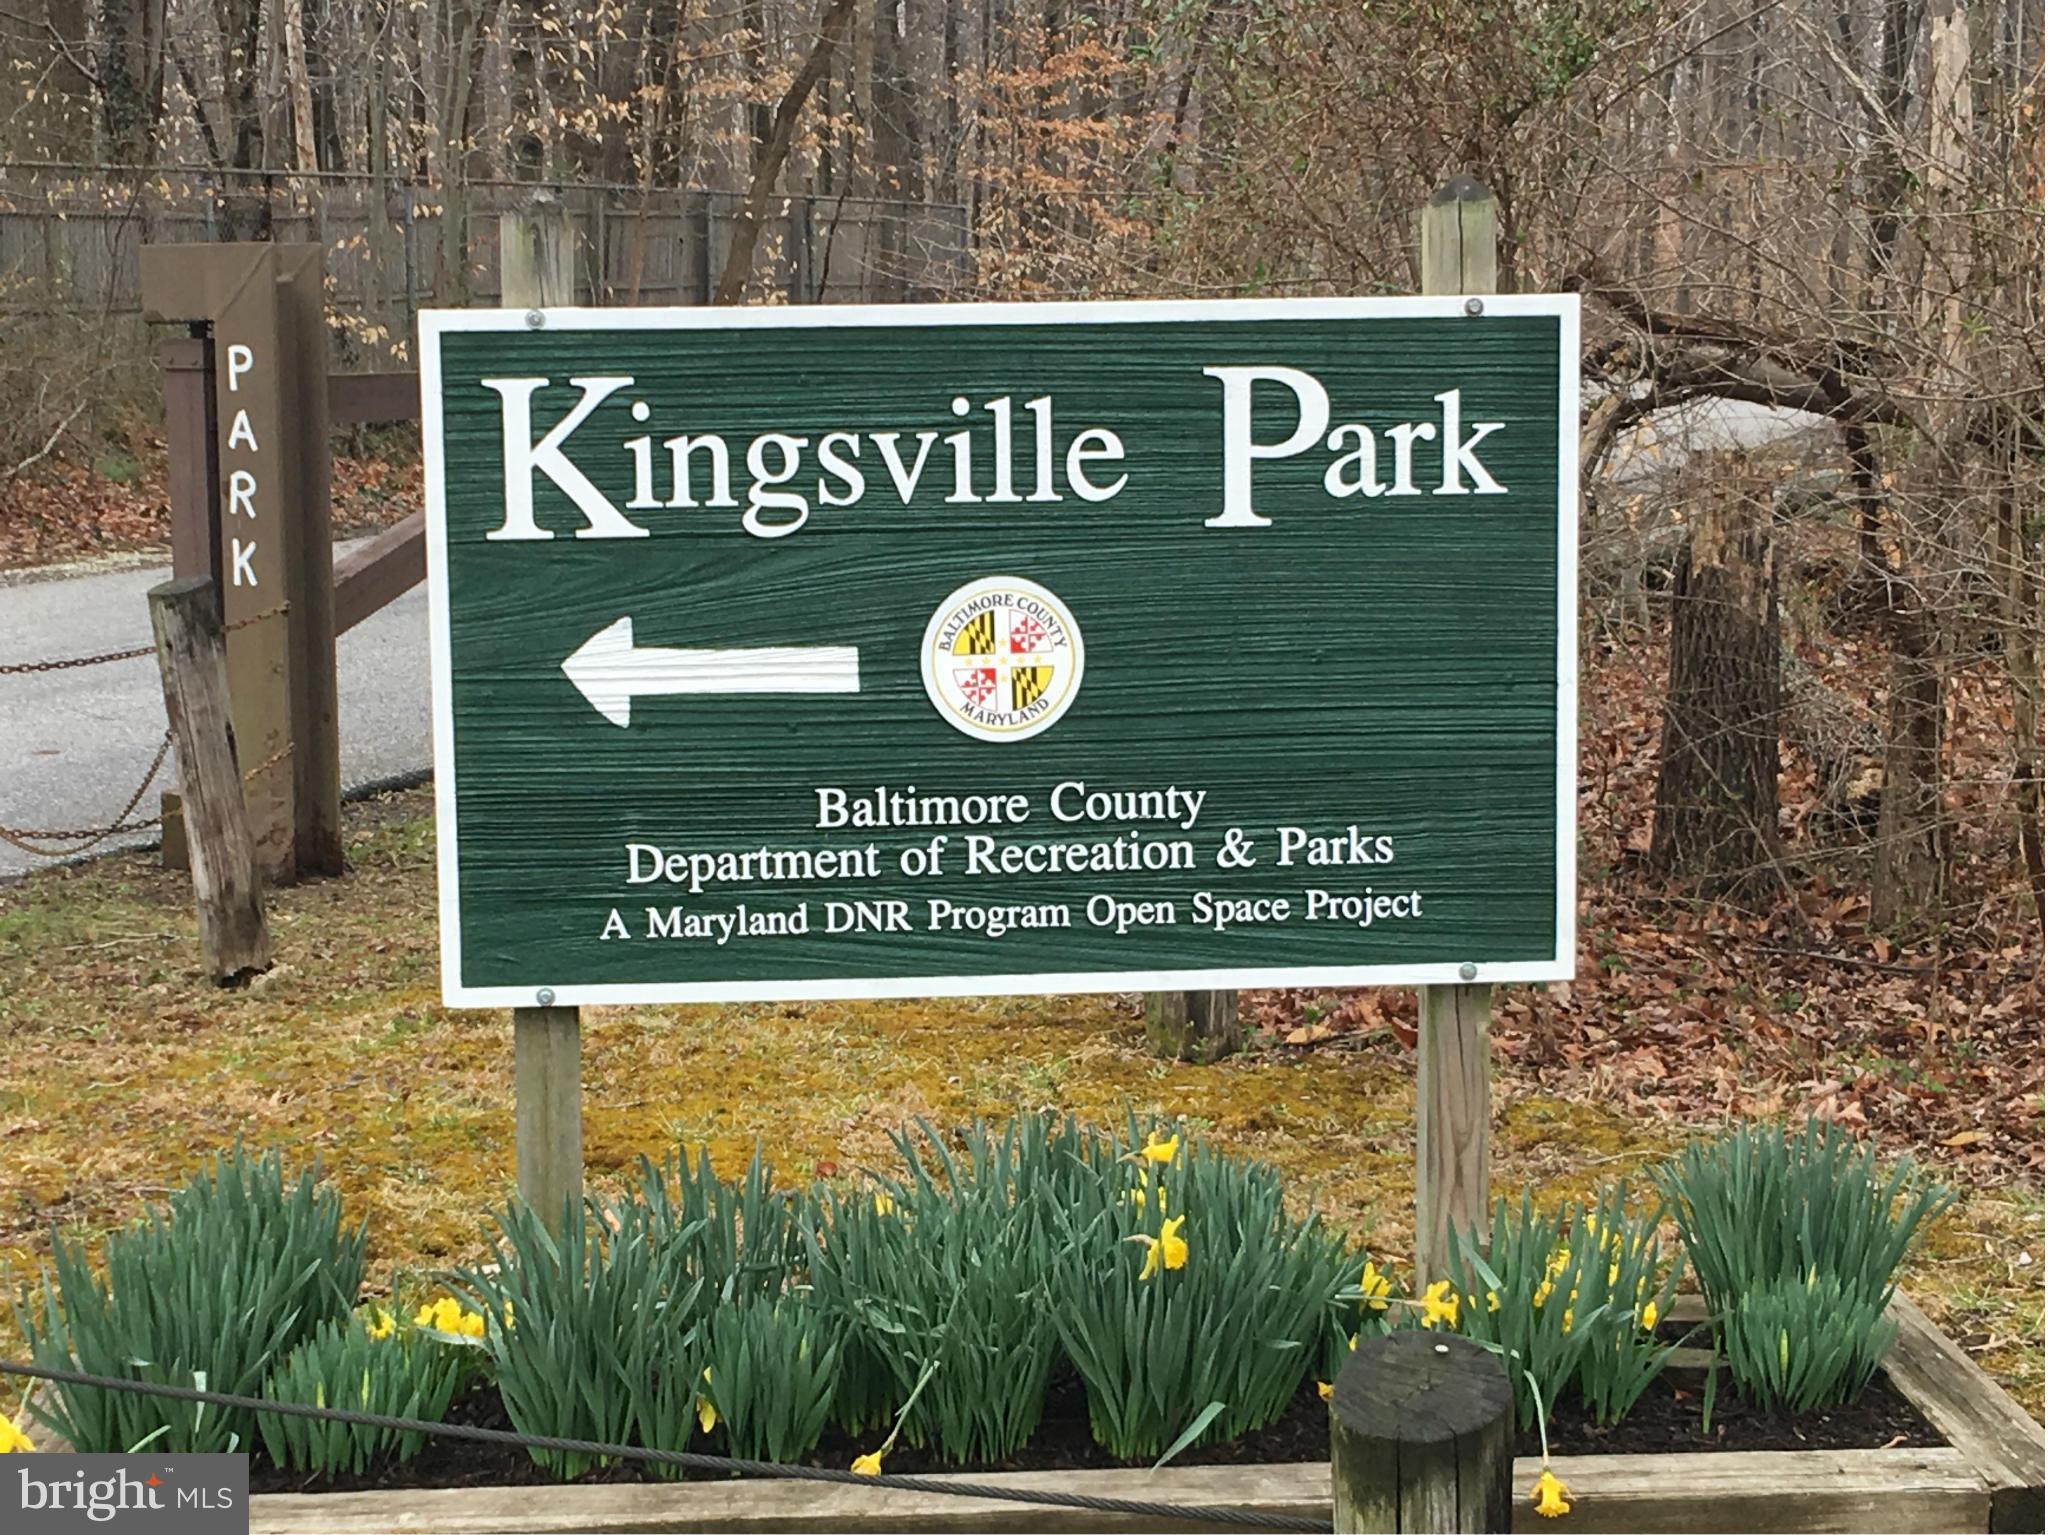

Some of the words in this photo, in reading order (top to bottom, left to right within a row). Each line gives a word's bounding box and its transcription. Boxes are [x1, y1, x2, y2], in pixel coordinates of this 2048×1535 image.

[227, 344, 259, 588] PARK
[481, 376, 1129, 539] Kingsville
[1203, 366, 1508, 527] Park
[938, 593, 1014, 652] BALTIMORE
[1016, 596, 1068, 648] COUNTY
[959, 698, 1050, 727] MARYLAND
[815, 785, 1029, 828] Baltimore
[1050, 781, 1207, 829] County
[626, 842, 881, 893] Department
[900, 835, 948, 876] of
[965, 830, 1196, 875] Recreation
[1216, 828, 1257, 868] &
[1276, 824, 1394, 866] Parks
[600, 908, 631, 940] A
[646, 902, 810, 945] Maryland
[825, 900, 913, 933] DNR
[928, 899, 1072, 937] Program
[1086, 894, 1176, 934] Open
[1191, 891, 1291, 931] Space
[1305, 887, 1423, 927] Project
